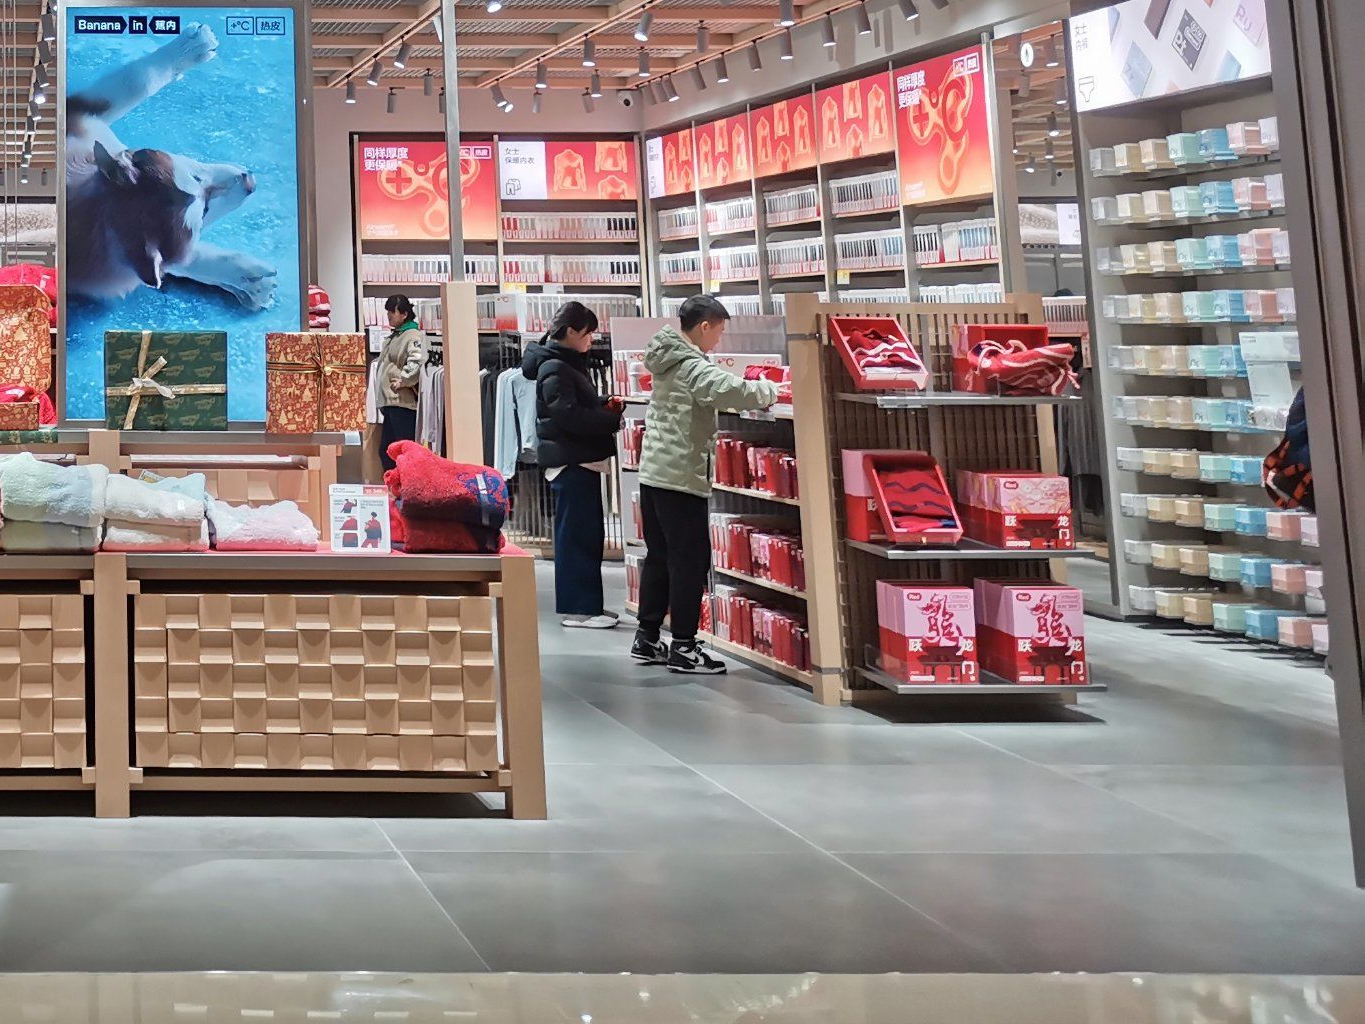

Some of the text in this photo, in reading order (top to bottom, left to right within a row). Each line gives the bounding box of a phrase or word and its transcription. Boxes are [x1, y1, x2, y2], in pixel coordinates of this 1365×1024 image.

[78, 19, 121, 31] Banana
[132, 19, 144, 31] in
[363, 147, 409, 160] 同样厚度
[505, 147, 520, 156] 女士
[504, 156, 535, 165] 保暖内衣
